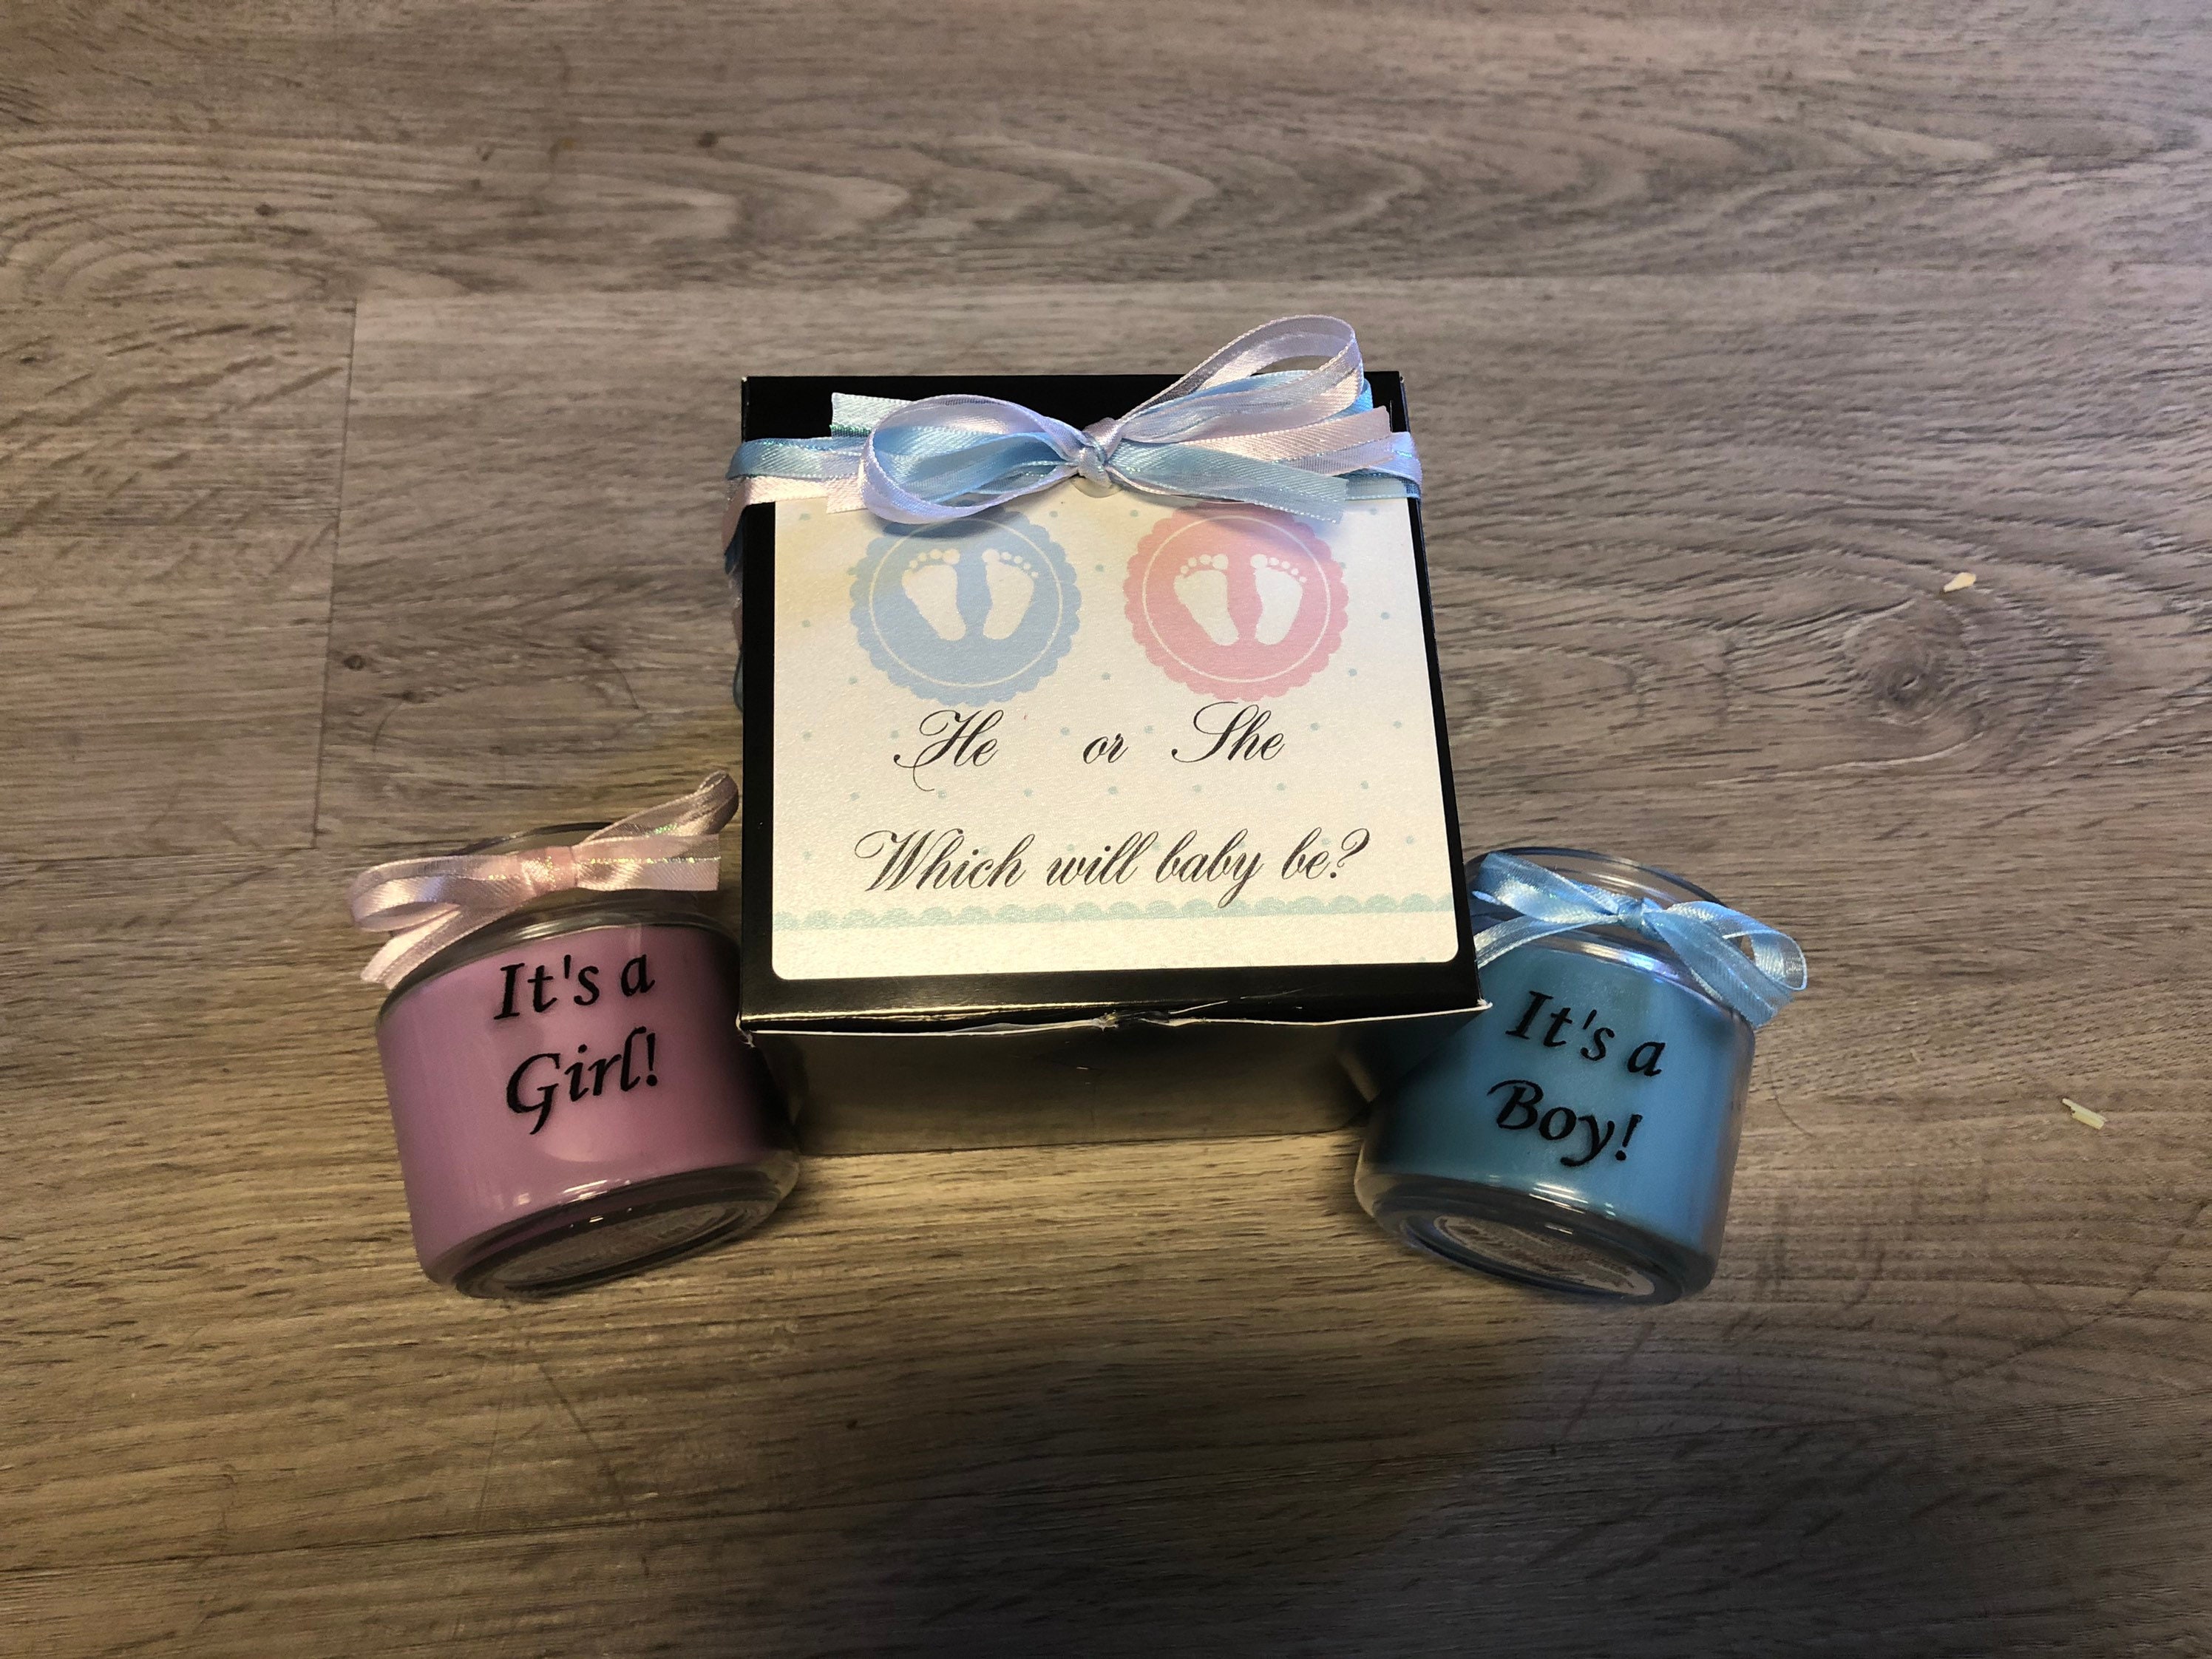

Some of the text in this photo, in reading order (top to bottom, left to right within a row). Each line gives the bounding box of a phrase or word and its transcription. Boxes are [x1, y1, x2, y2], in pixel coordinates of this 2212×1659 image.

[893, 701, 1285, 792] He or She
[854, 827, 1371, 909] Which will baby be?
[493, 954, 656, 1020] It's a
[1504, 989, 1666, 1077] It's a
[506, 1025, 659, 1136] Girl!
[1486, 1079, 1643, 1167] Boy!
